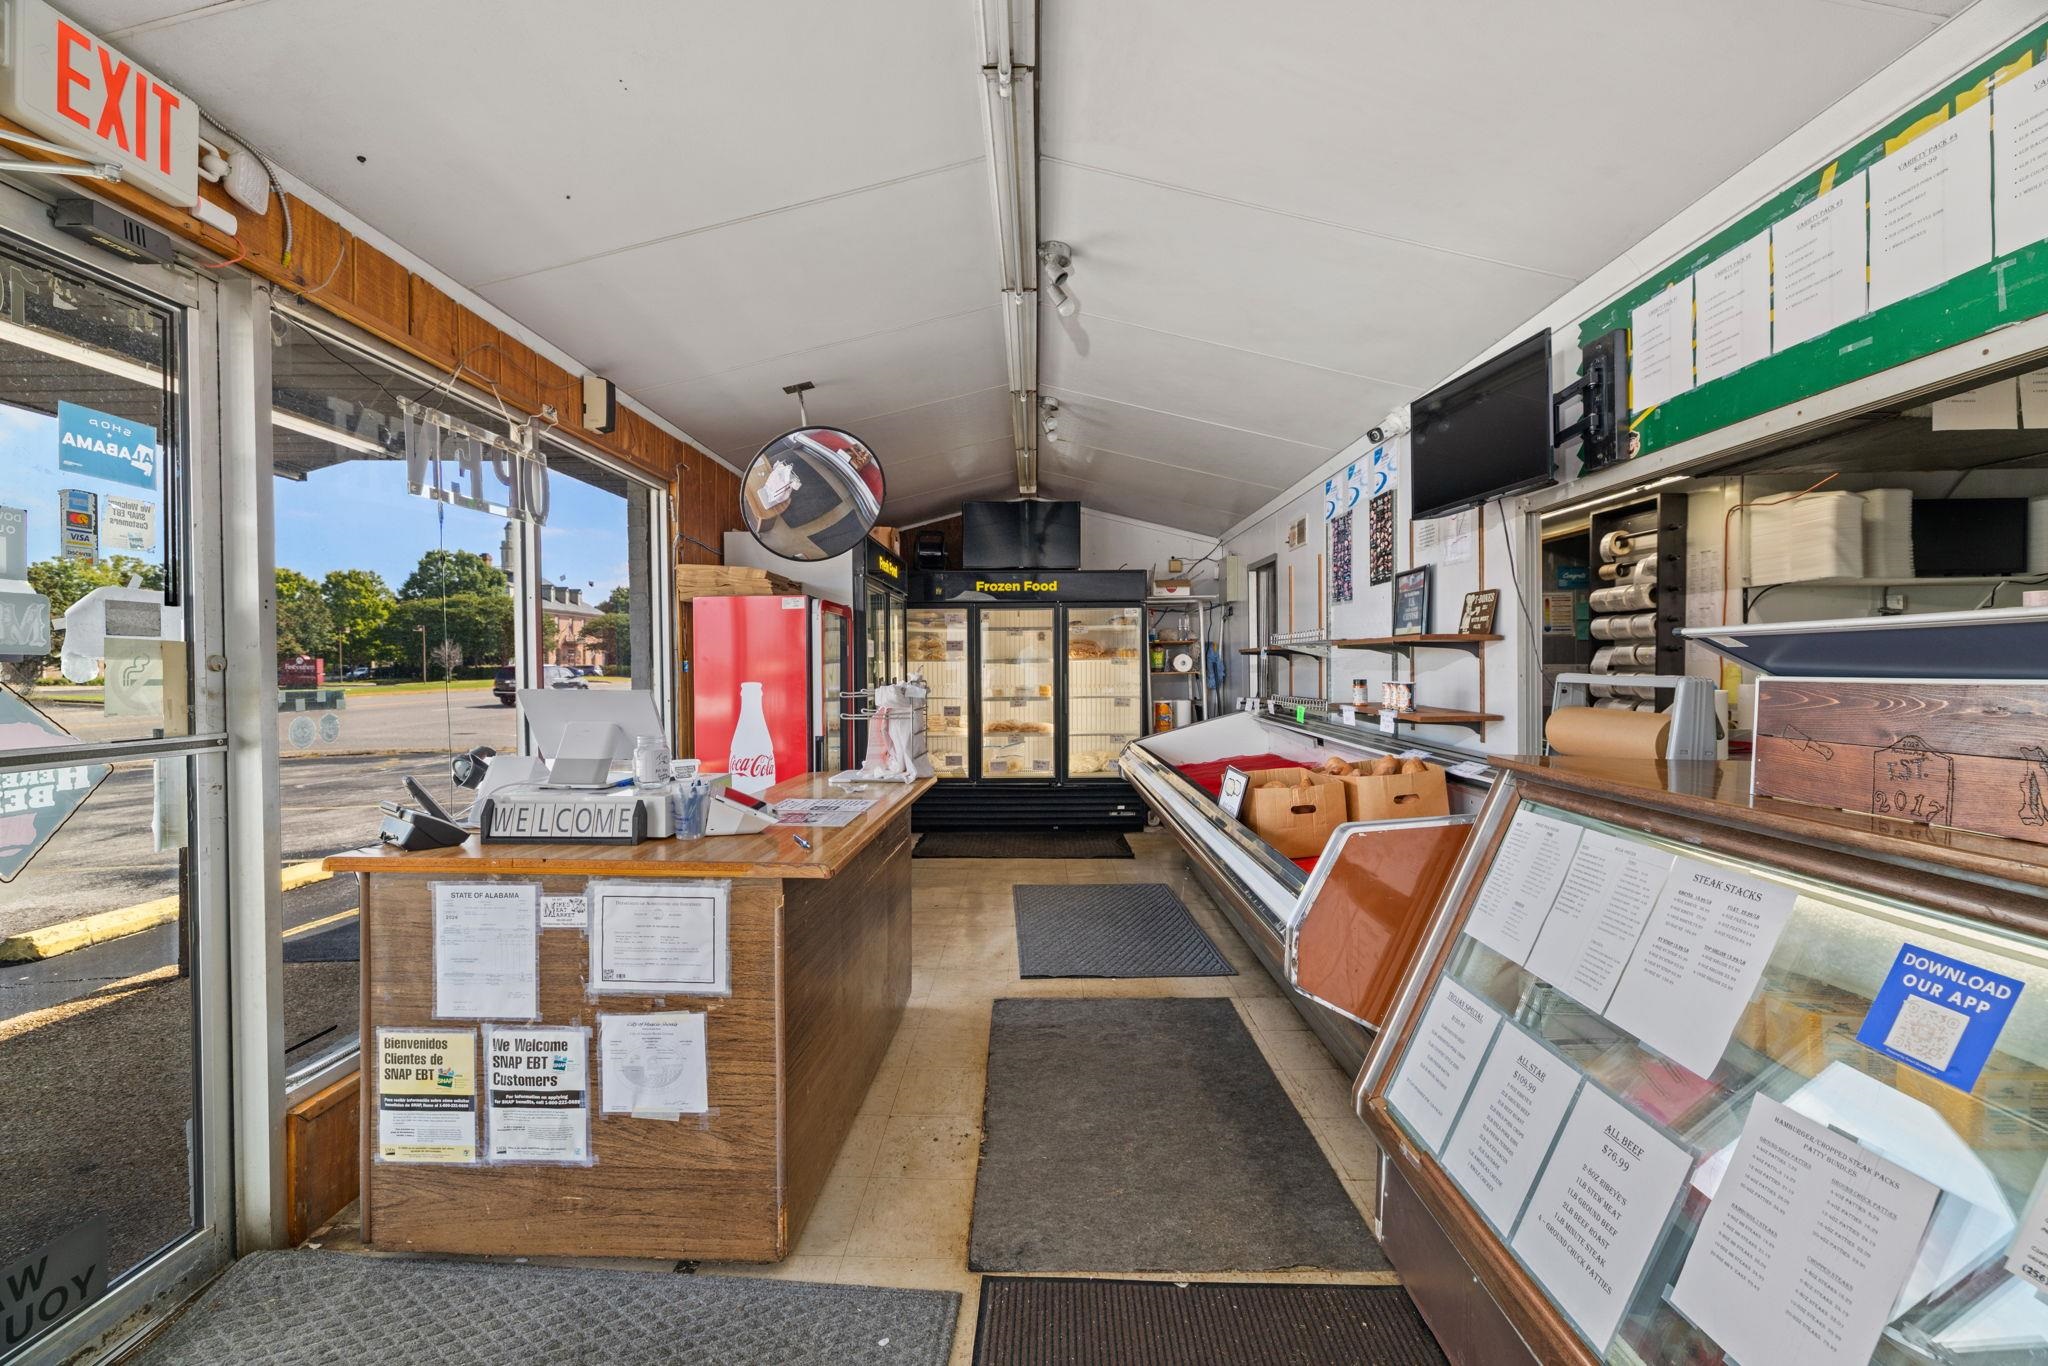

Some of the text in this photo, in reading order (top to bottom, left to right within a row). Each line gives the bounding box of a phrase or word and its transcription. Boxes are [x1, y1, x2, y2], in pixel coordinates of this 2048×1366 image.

[57, 20, 179, 175] EXIT
[70, 533, 90, 542] VISA
[976, 580, 1057, 592] Frozen Food
[731, 754, 774, 777] oca-Cola
[493, 802, 632, 834] WELCOME
[1692, 874, 1763, 902] STEAK STACKS
[1902, 952, 2012, 999] DOWNLOAD
[1902, 974, 1991, 1014] OUR APP
[384, 1037, 448, 1050] Bienvenidos
[493, 1038, 568, 1052] We Welcome
[384, 1053, 443, 1065] Clientes de
[493, 1055, 548, 1070] SNAP EBT
[1517, 1053, 1546, 1082] ALL STAR
[384, 1068, 435, 1081] SNAP EBT
[493, 1072, 558, 1087] Customers
[1512, 1069, 1536, 1094] $109.99
[1604, 1123, 1644, 1159] ALL BEEF
[1773, 1116, 1900, 1190] HAMBURGER/CHOPPED STEAK PACKS
[1600, 1143, 1630, 1173] $76.99
[1802, 1143, 1857, 1177] PATTY BUNDLES
[1575, 1176, 1622, 1221] 1LB STEW MEAT
[1598, 1177, 1627, 1206] RIBEYE'S
[1562, 1200, 1609, 1250] 2LB BEEF ROAST
[1567, 1186, 1618, 1238] 1LB GROUND BEEF
[1554, 1211, 1606, 1267] 1LB MINUTE STEAK
[1545, 1221, 1567, 1247] GROUND
[1566, 1243, 1585, 1267] CHUCK
[1585, 1264, 1612, 1296] PATTIES
